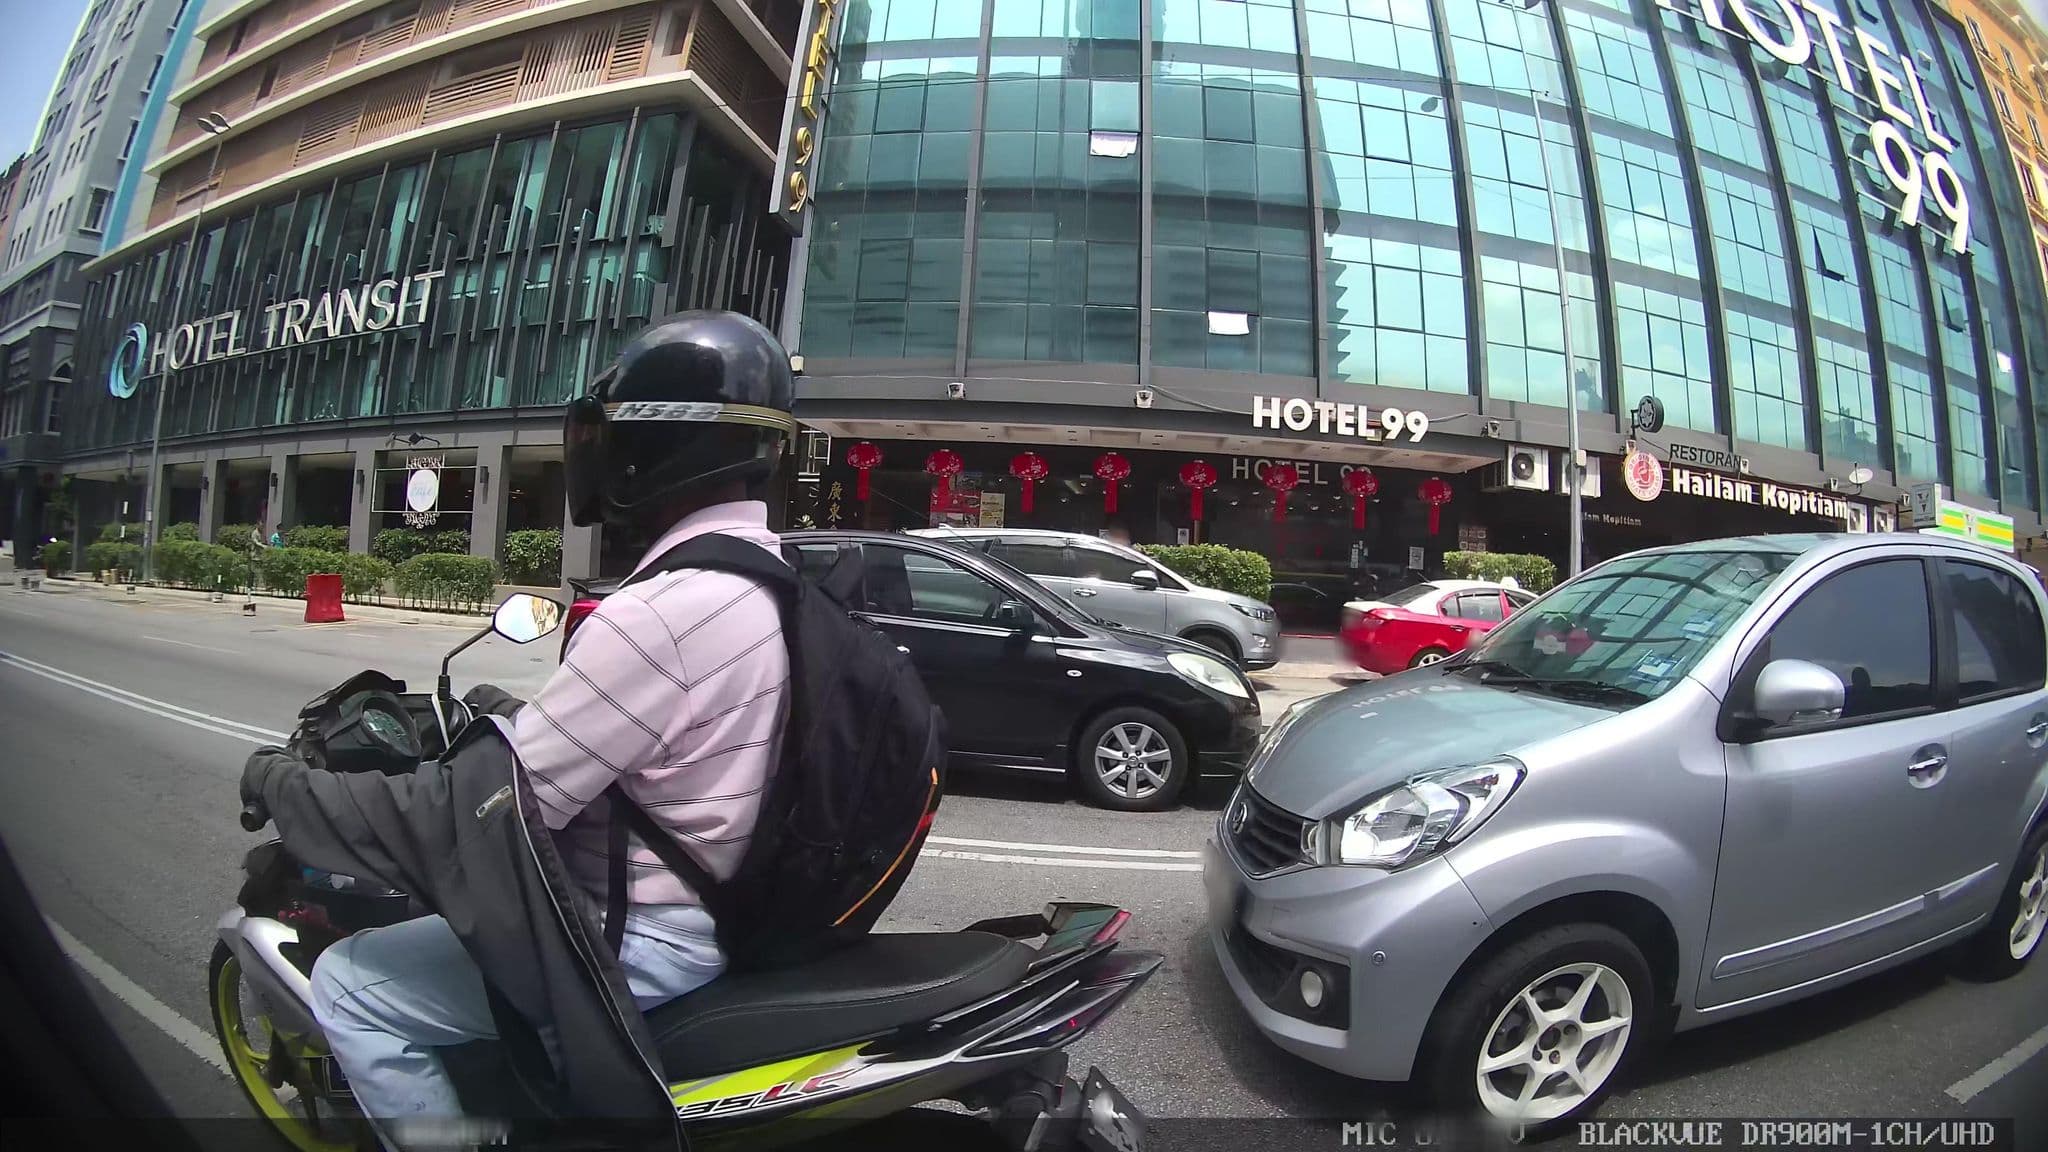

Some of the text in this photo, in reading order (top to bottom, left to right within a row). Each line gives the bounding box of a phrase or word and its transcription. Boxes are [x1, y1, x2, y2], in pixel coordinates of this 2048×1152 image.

[789, 0, 837, 213] TEL 99
[1869, 120, 1969, 254] 99
[150, 270, 446, 375] HOTEL TRANSIT
[1252, 395, 1430, 443] HOTEL 99
[1232, 456, 1329, 486] HOEL
[1669, 443, 1741, 472] RESTORAN
[828, 481, 843, 529] 廣東
[1672, 467, 1753, 505] Hailam
[1762, 482, 1848, 520] Kopitiam
[677, 1066, 860, 1119] 35LC
